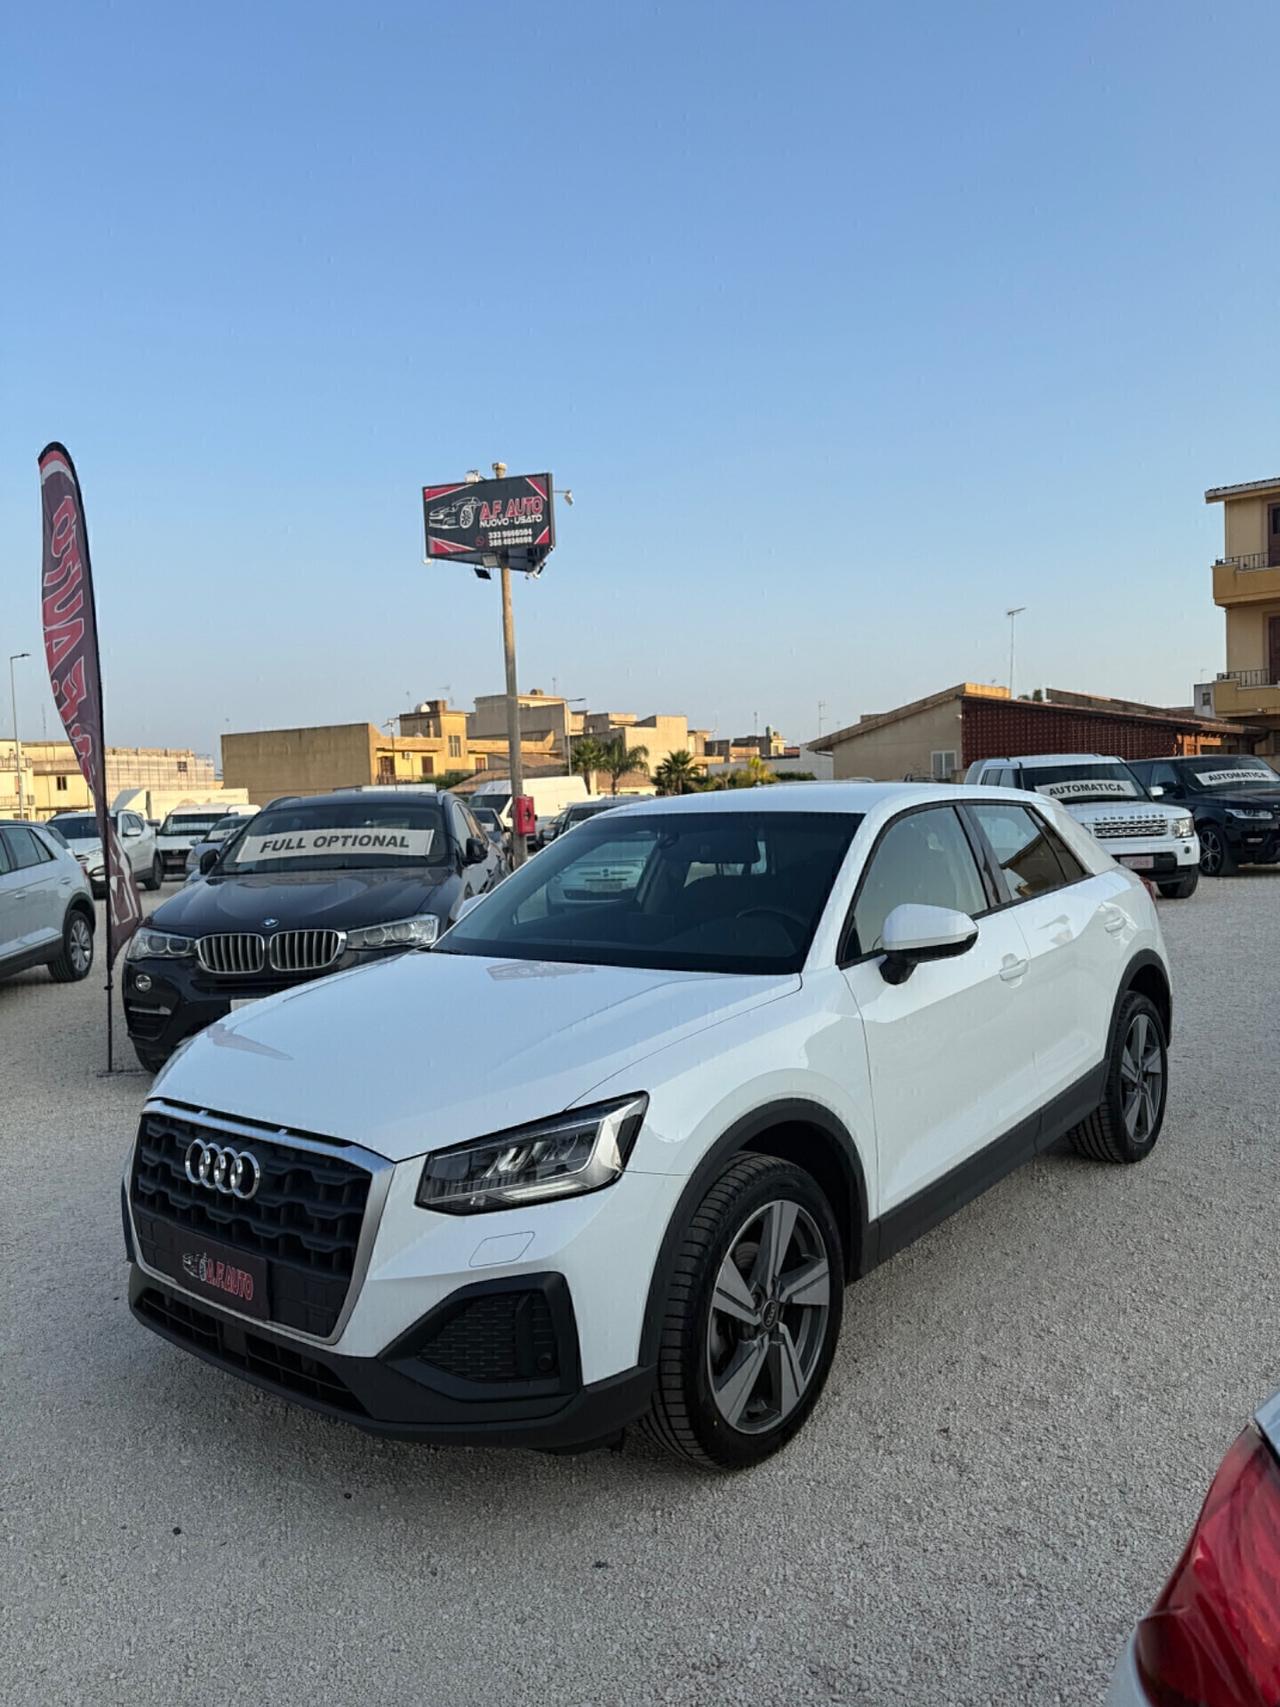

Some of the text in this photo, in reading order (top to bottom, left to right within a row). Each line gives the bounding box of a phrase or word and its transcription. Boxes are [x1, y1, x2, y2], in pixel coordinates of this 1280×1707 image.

[505, 495, 544, 517] AUTO
[479, 517, 509, 528] NUOVO
[514, 514, 543, 525] USATO
[1208, 771, 1269, 782] AUTOMATICA
[1049, 783, 1125, 796] AUTOMATICA
[259, 834, 410, 854] FULL OPTIONAL
